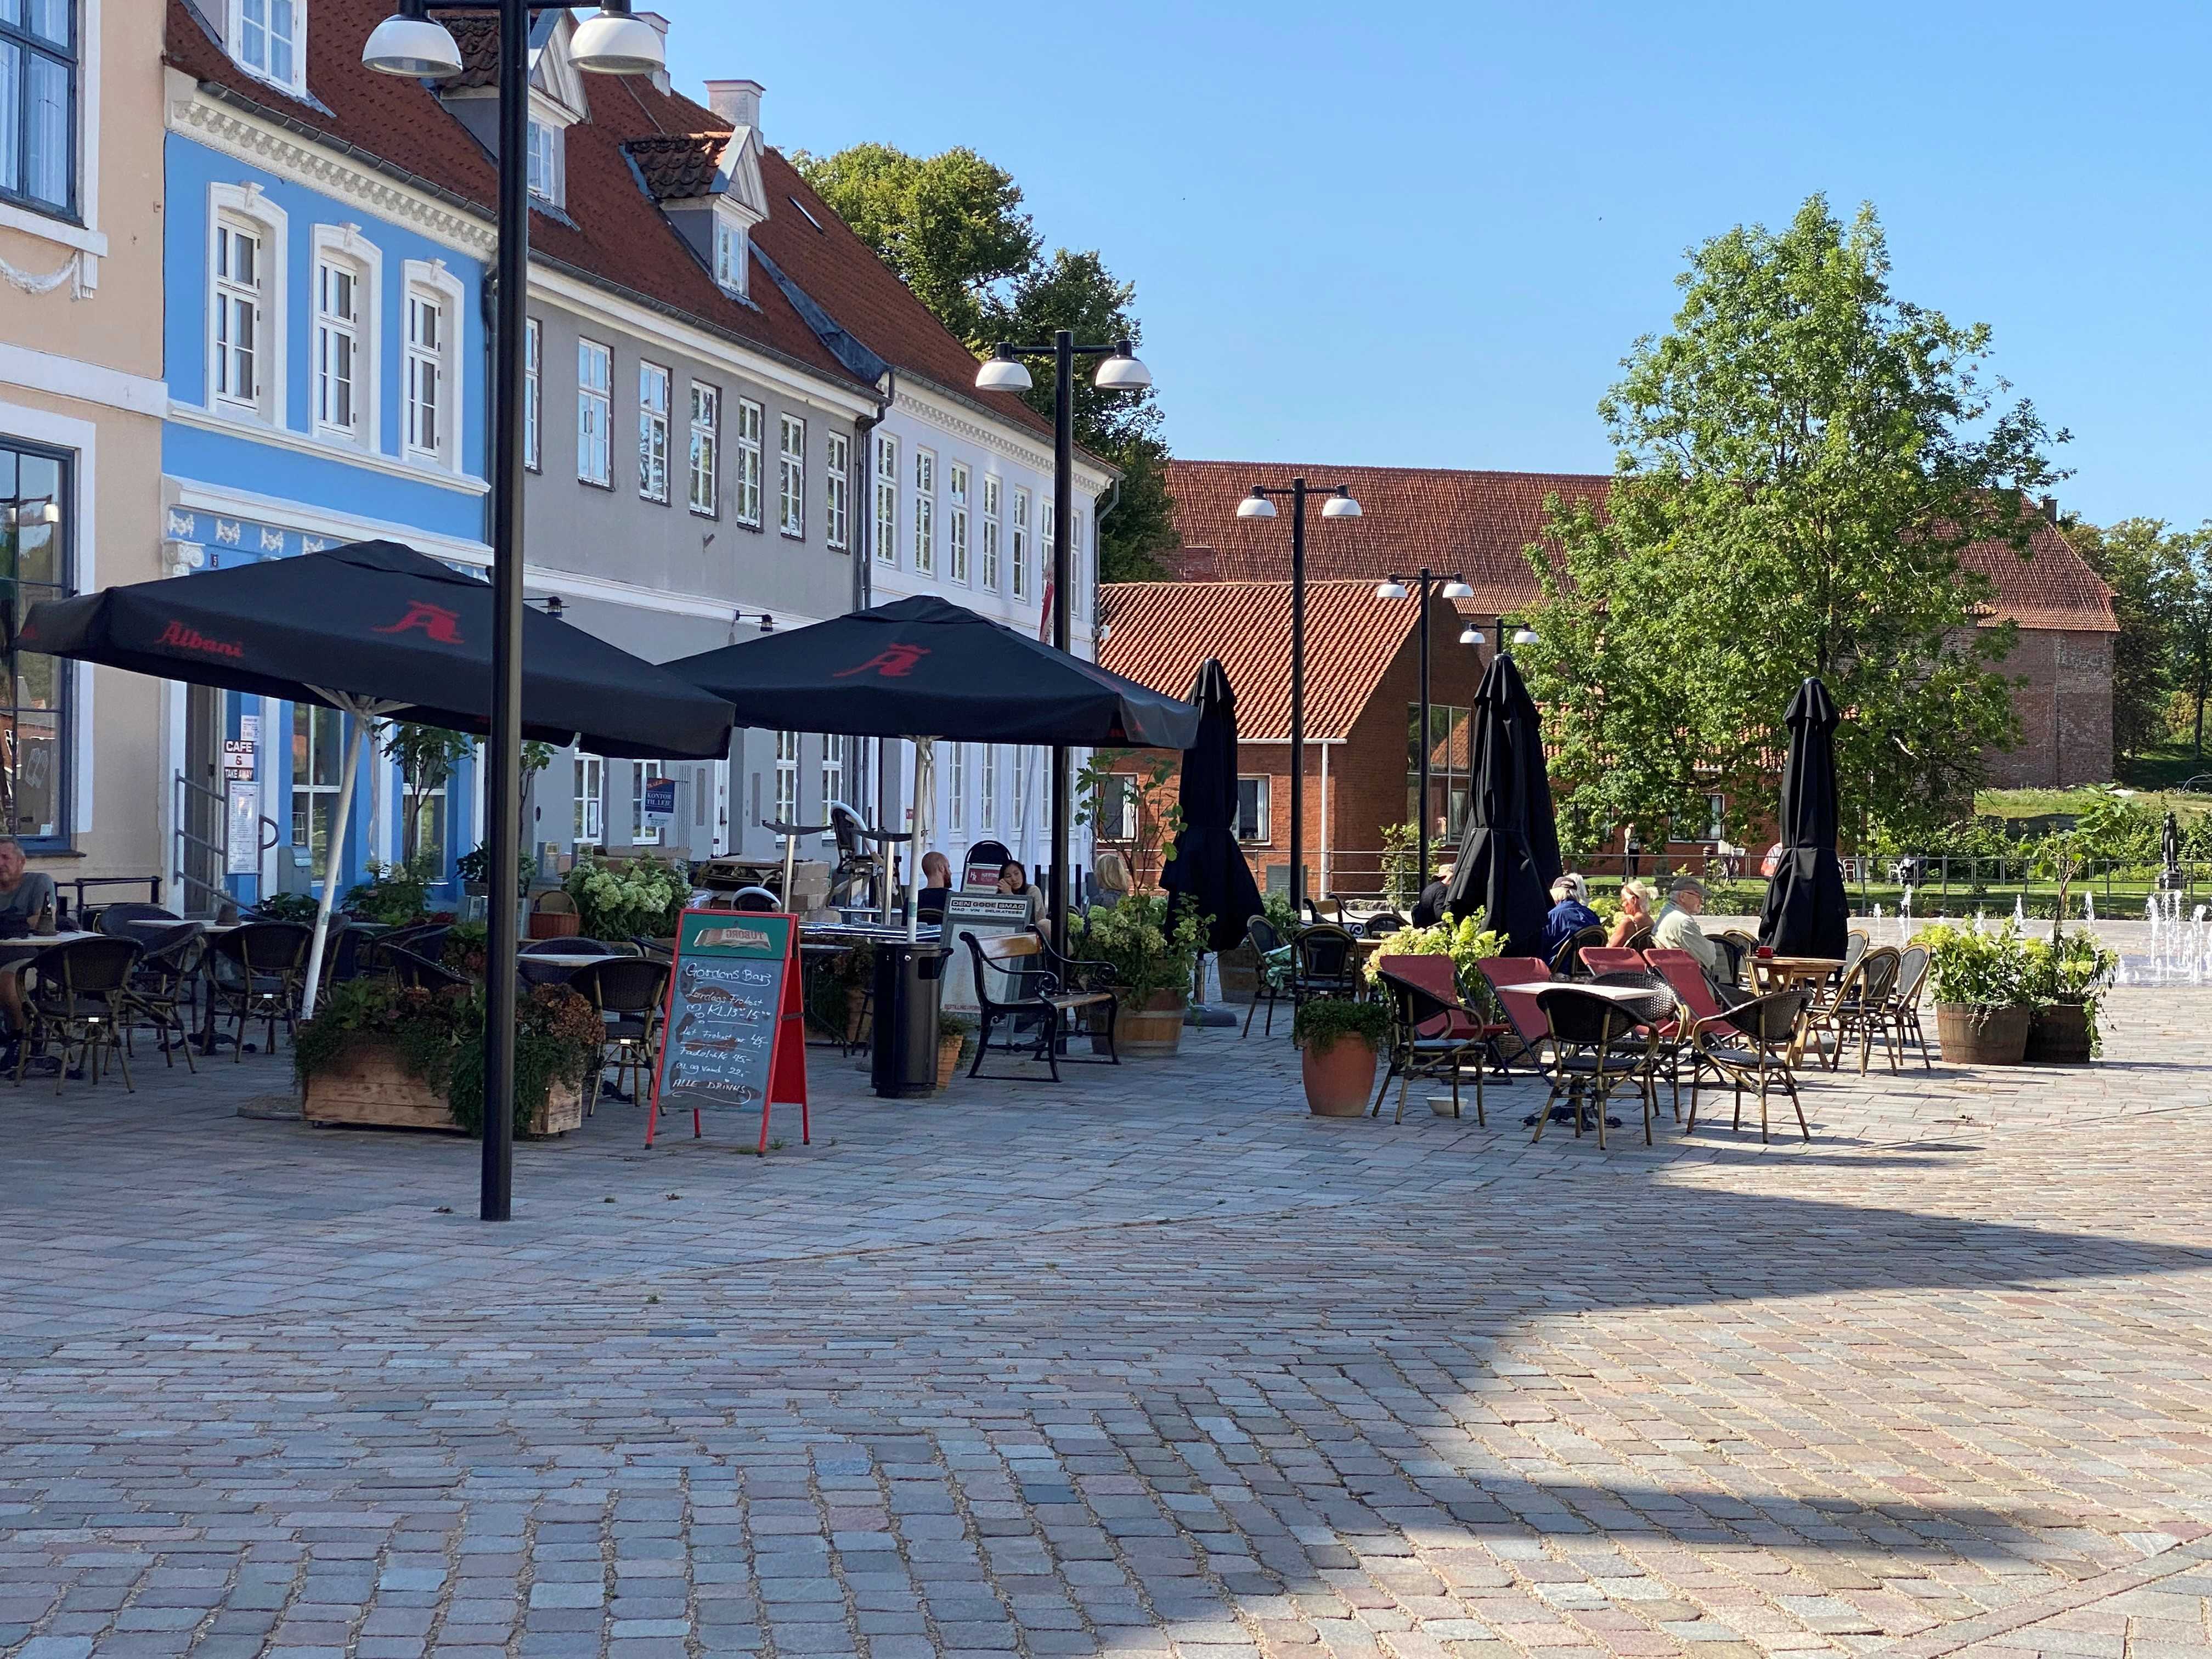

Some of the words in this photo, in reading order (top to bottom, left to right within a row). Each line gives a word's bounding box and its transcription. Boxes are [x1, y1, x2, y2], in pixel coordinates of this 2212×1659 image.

[155, 619, 243, 657] Albani
[226, 741, 253, 753] CAFE
[236, 755, 242, 765] &
[225, 769, 238, 778] TAKE
[238, 769, 253, 779] AWAY
[686, 963, 740, 980] Gordons
[742, 969, 771, 981] Bar
[673, 1079, 699, 1087] ALLE
